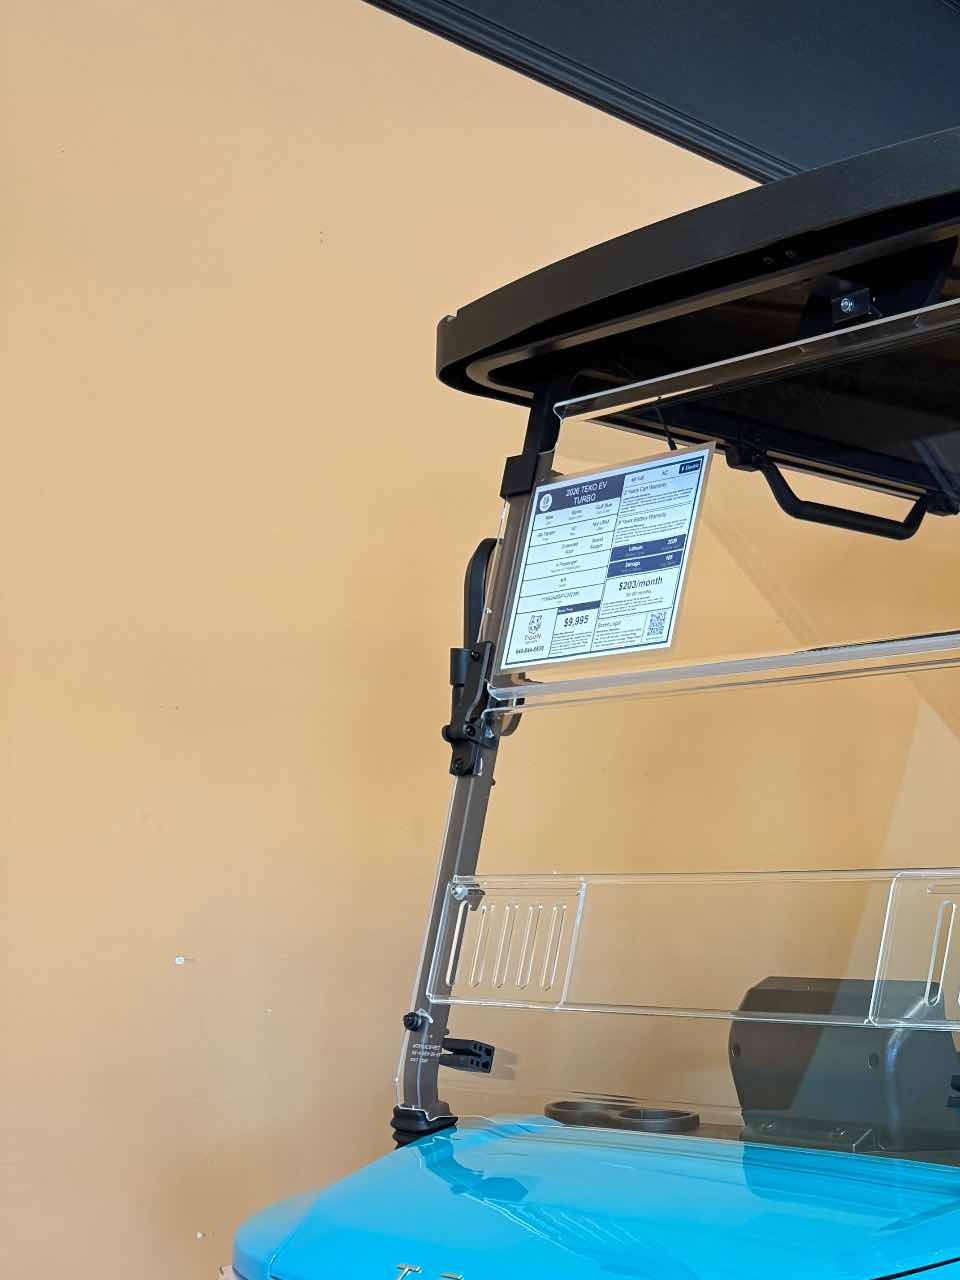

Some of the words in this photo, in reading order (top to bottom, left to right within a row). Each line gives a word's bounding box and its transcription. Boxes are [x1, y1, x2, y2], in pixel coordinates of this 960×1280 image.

[581, 483, 598, 493] TEKO
[598, 480, 608, 490] EV
[573, 493, 597, 505] TURBO
[618, 576, 663, 591] $203/month
[563, 614, 590, 628] $9,995
